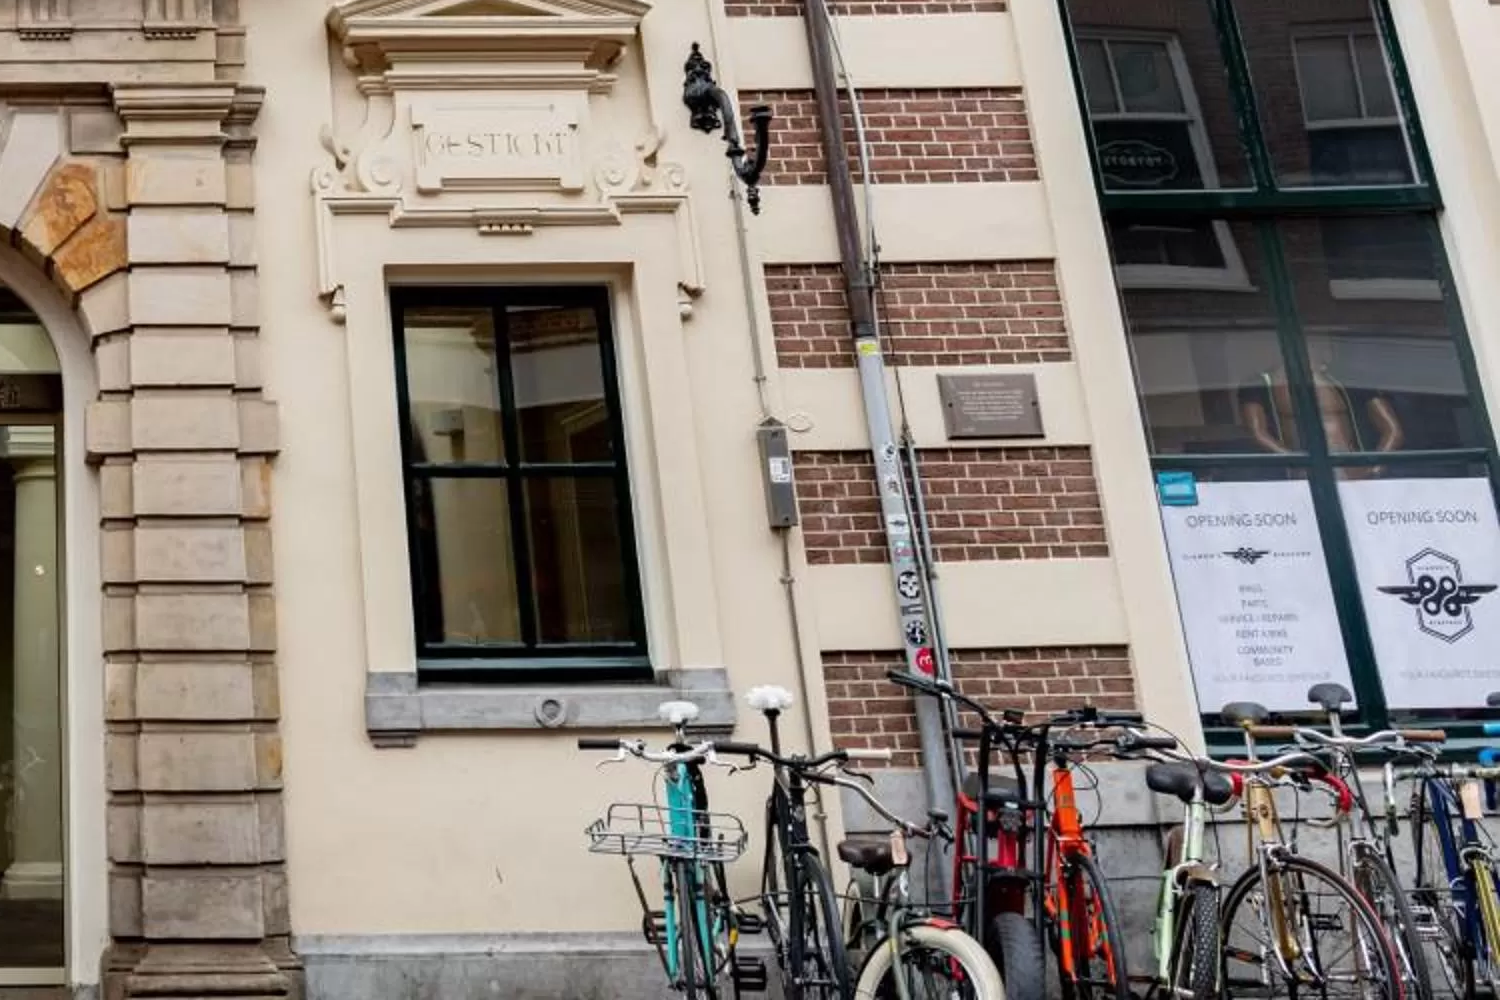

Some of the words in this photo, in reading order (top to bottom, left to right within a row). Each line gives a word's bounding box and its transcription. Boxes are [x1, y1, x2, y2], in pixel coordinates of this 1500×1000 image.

[1185, 514, 1252, 528] OPENING
[1255, 512, 1298, 527] SOON
[1367, 510, 1433, 526] OPENING
[1435, 510, 1478, 524] SOON
